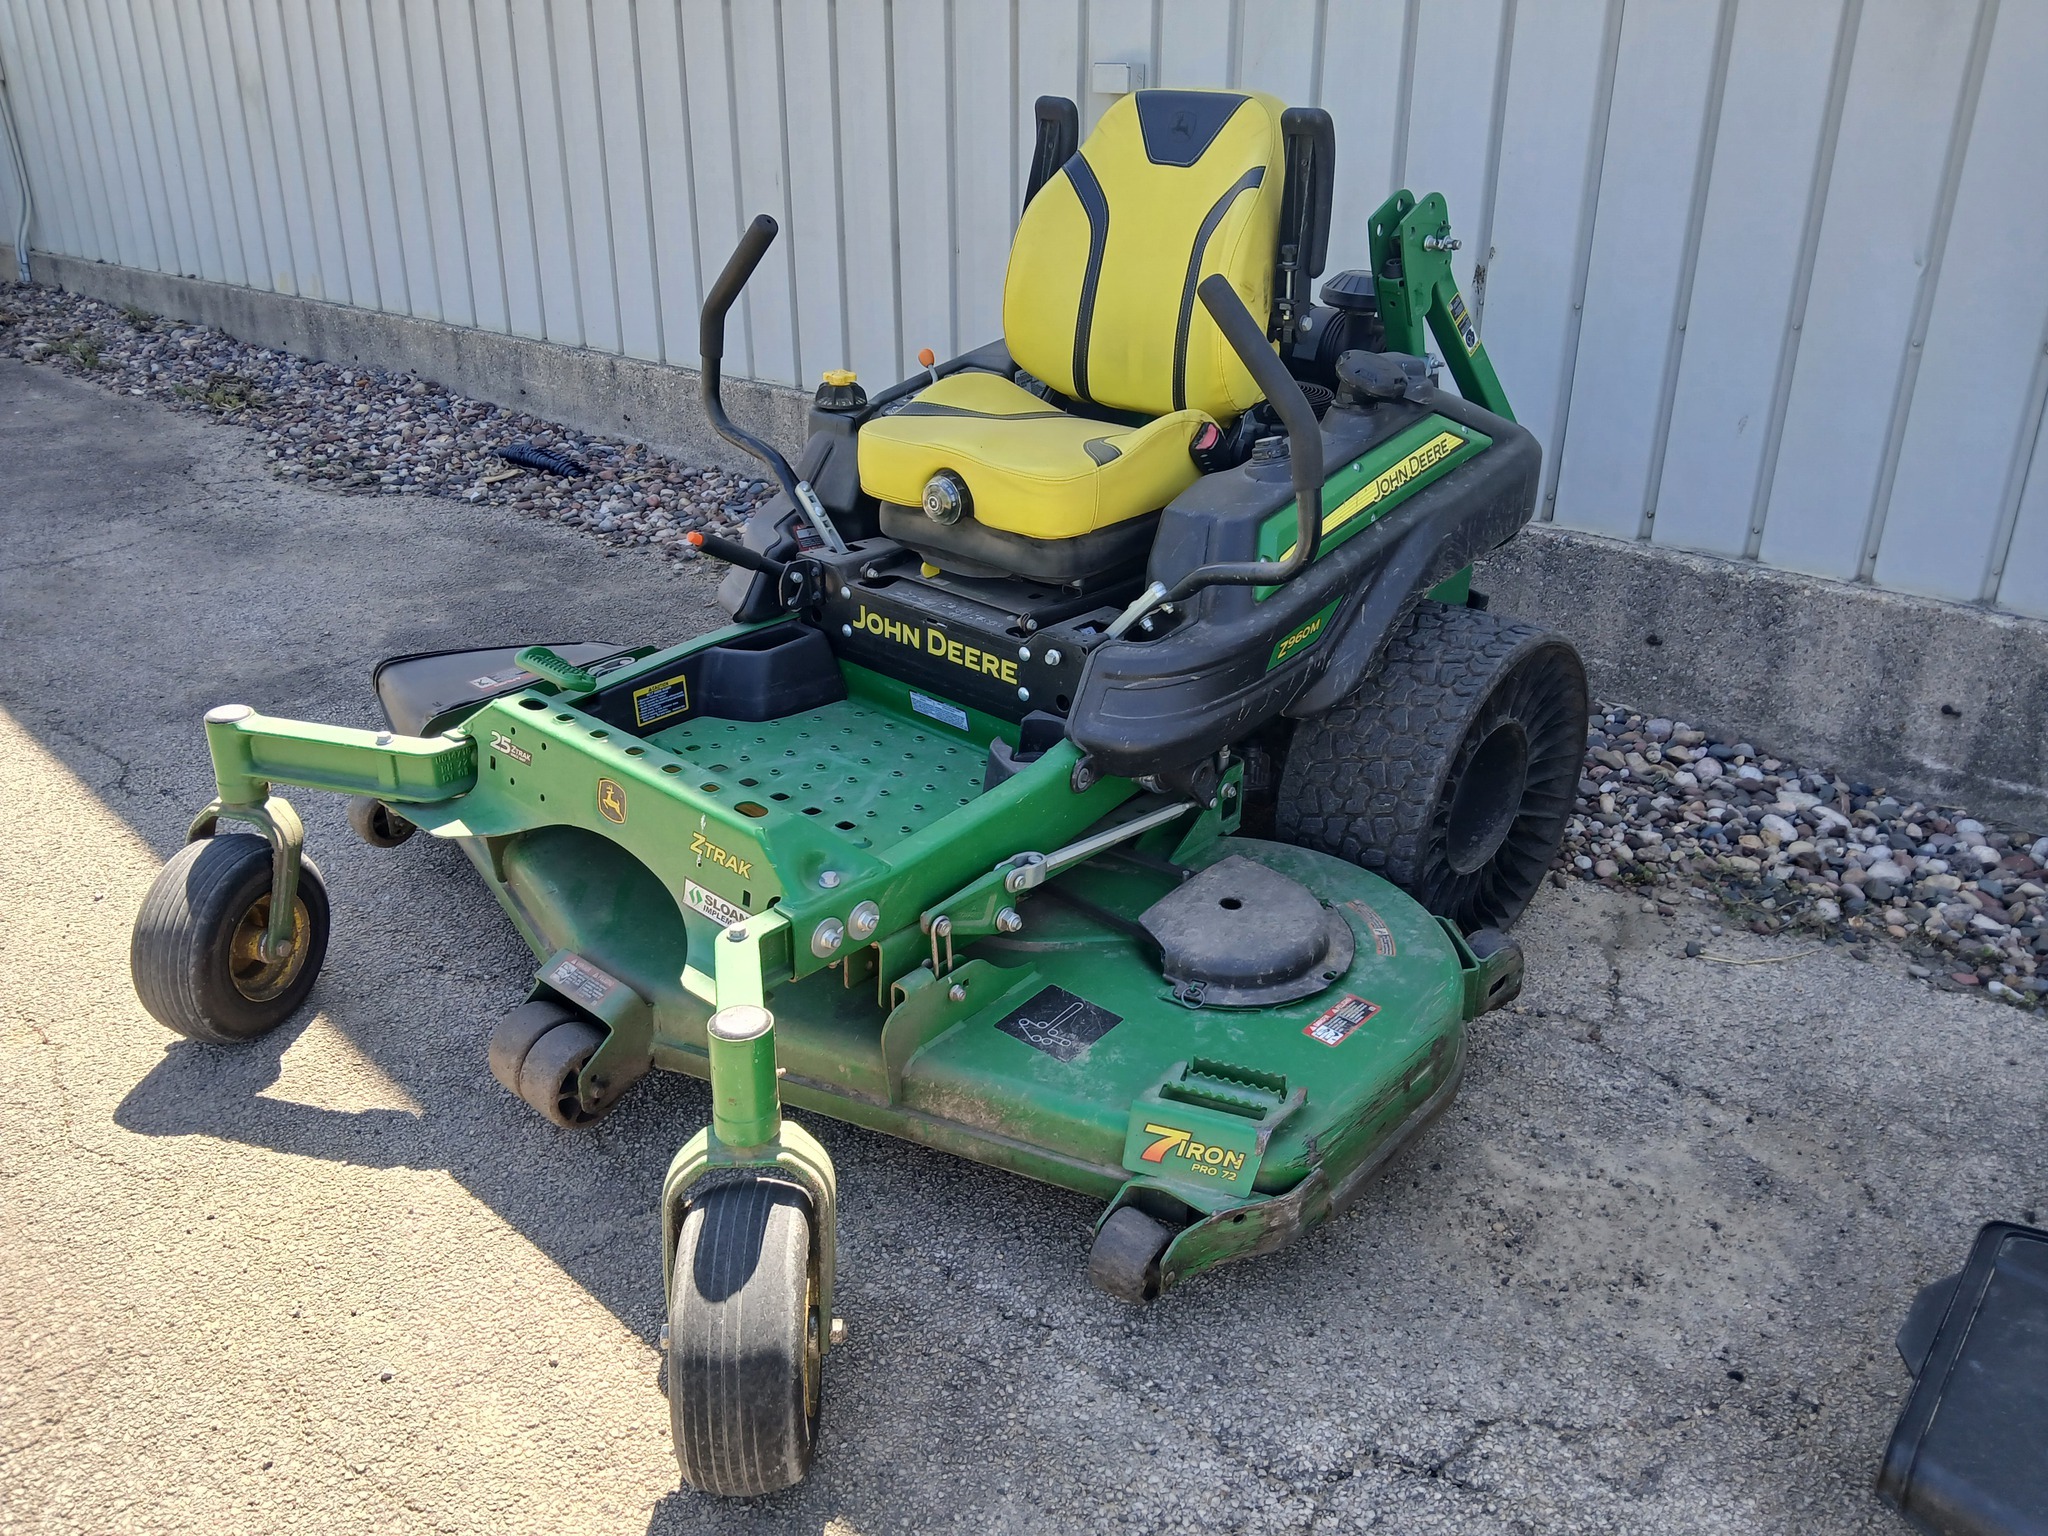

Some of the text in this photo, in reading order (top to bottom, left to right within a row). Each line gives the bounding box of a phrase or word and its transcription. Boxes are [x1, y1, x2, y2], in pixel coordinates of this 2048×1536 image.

[1374, 438, 1450, 500] JOHN DEERE
[852, 605, 920, 649] JOHN
[927, 628, 1018, 685] DEERE
[1277, 618, 1321, 659] Z960M
[489, 730, 511, 754] 25
[510, 745, 531, 761] ZTRAK
[689, 831, 753, 880] ZTRAK
[1141, 1122, 1246, 1170] 7 IRON
[1191, 1163, 1238, 1181] PRO 72
